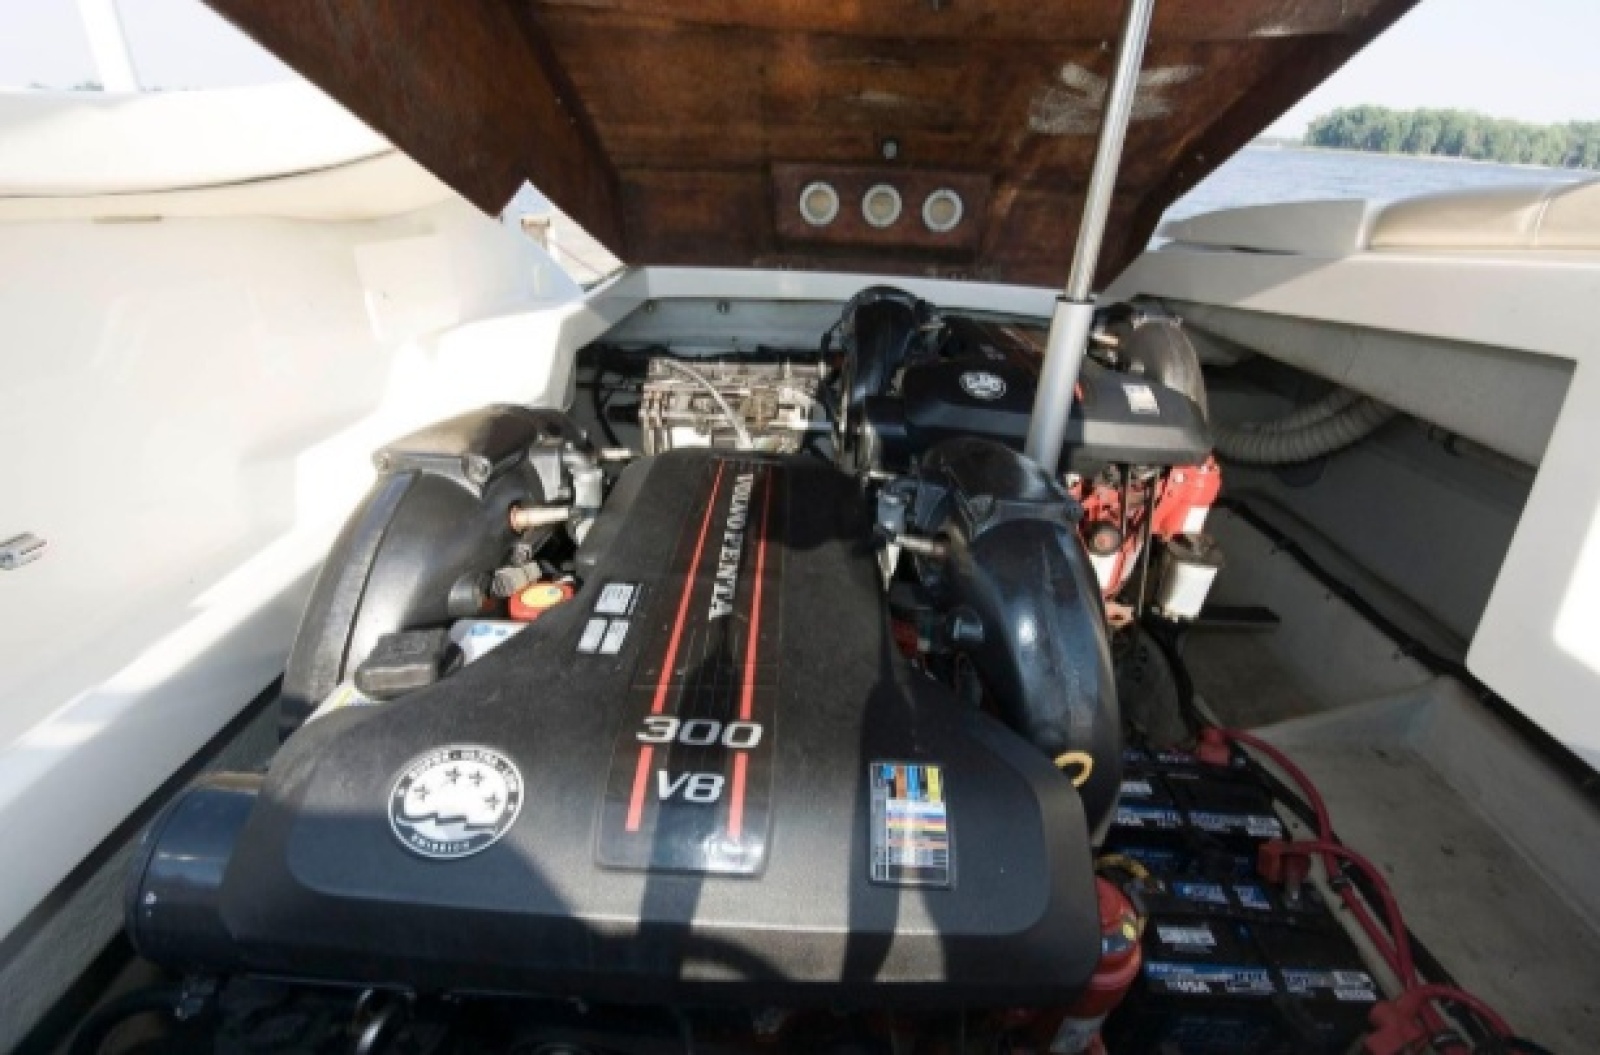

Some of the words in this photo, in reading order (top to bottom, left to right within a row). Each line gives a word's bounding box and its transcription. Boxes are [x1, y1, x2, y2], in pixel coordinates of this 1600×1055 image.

[708, 530, 744, 621] PENTA
[635, 715, 764, 749] 300
[657, 768, 726, 802] V8
